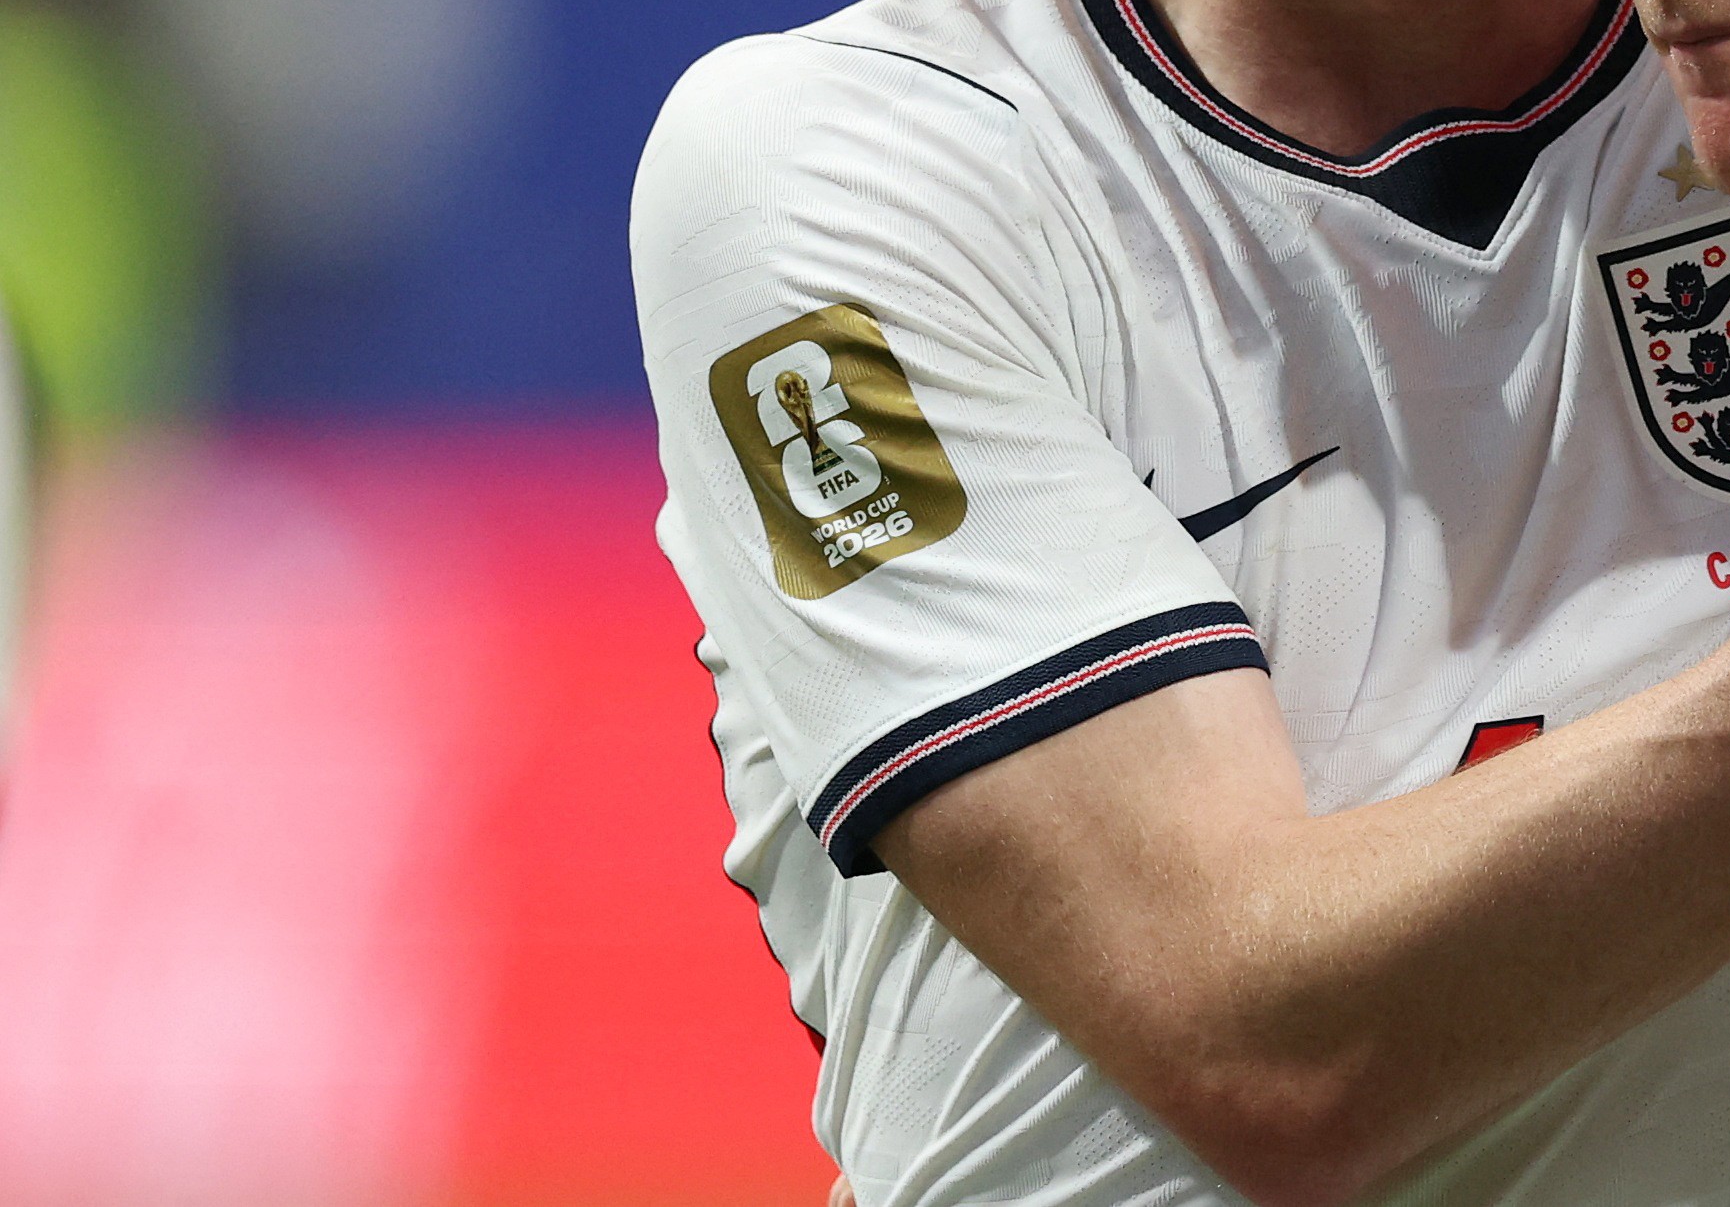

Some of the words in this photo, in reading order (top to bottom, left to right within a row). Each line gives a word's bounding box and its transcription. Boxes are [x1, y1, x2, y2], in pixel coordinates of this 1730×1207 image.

[817, 470, 860, 499] FIFA
[811, 509, 868, 544] WORLD
[868, 492, 899, 518] CUP
[823, 510, 914, 569] 2026
